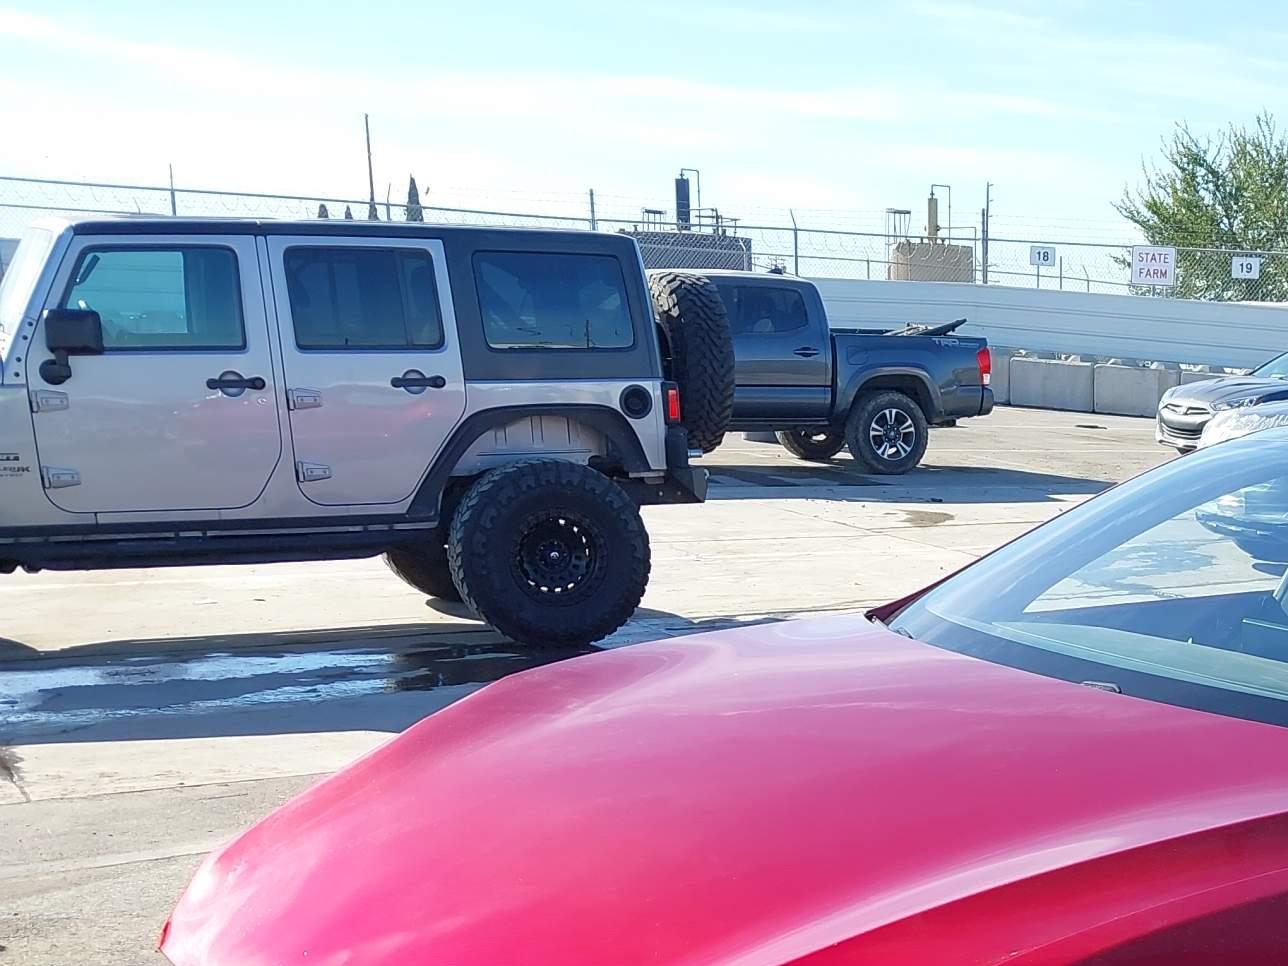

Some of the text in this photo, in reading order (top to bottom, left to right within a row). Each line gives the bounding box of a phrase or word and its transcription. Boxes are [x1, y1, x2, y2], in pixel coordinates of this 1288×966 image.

[1036, 251, 1049, 262] 18
[1138, 252, 1170, 264] STATE
[1138, 268, 1168, 280] FARM
[1239, 262, 1253, 274] 19
